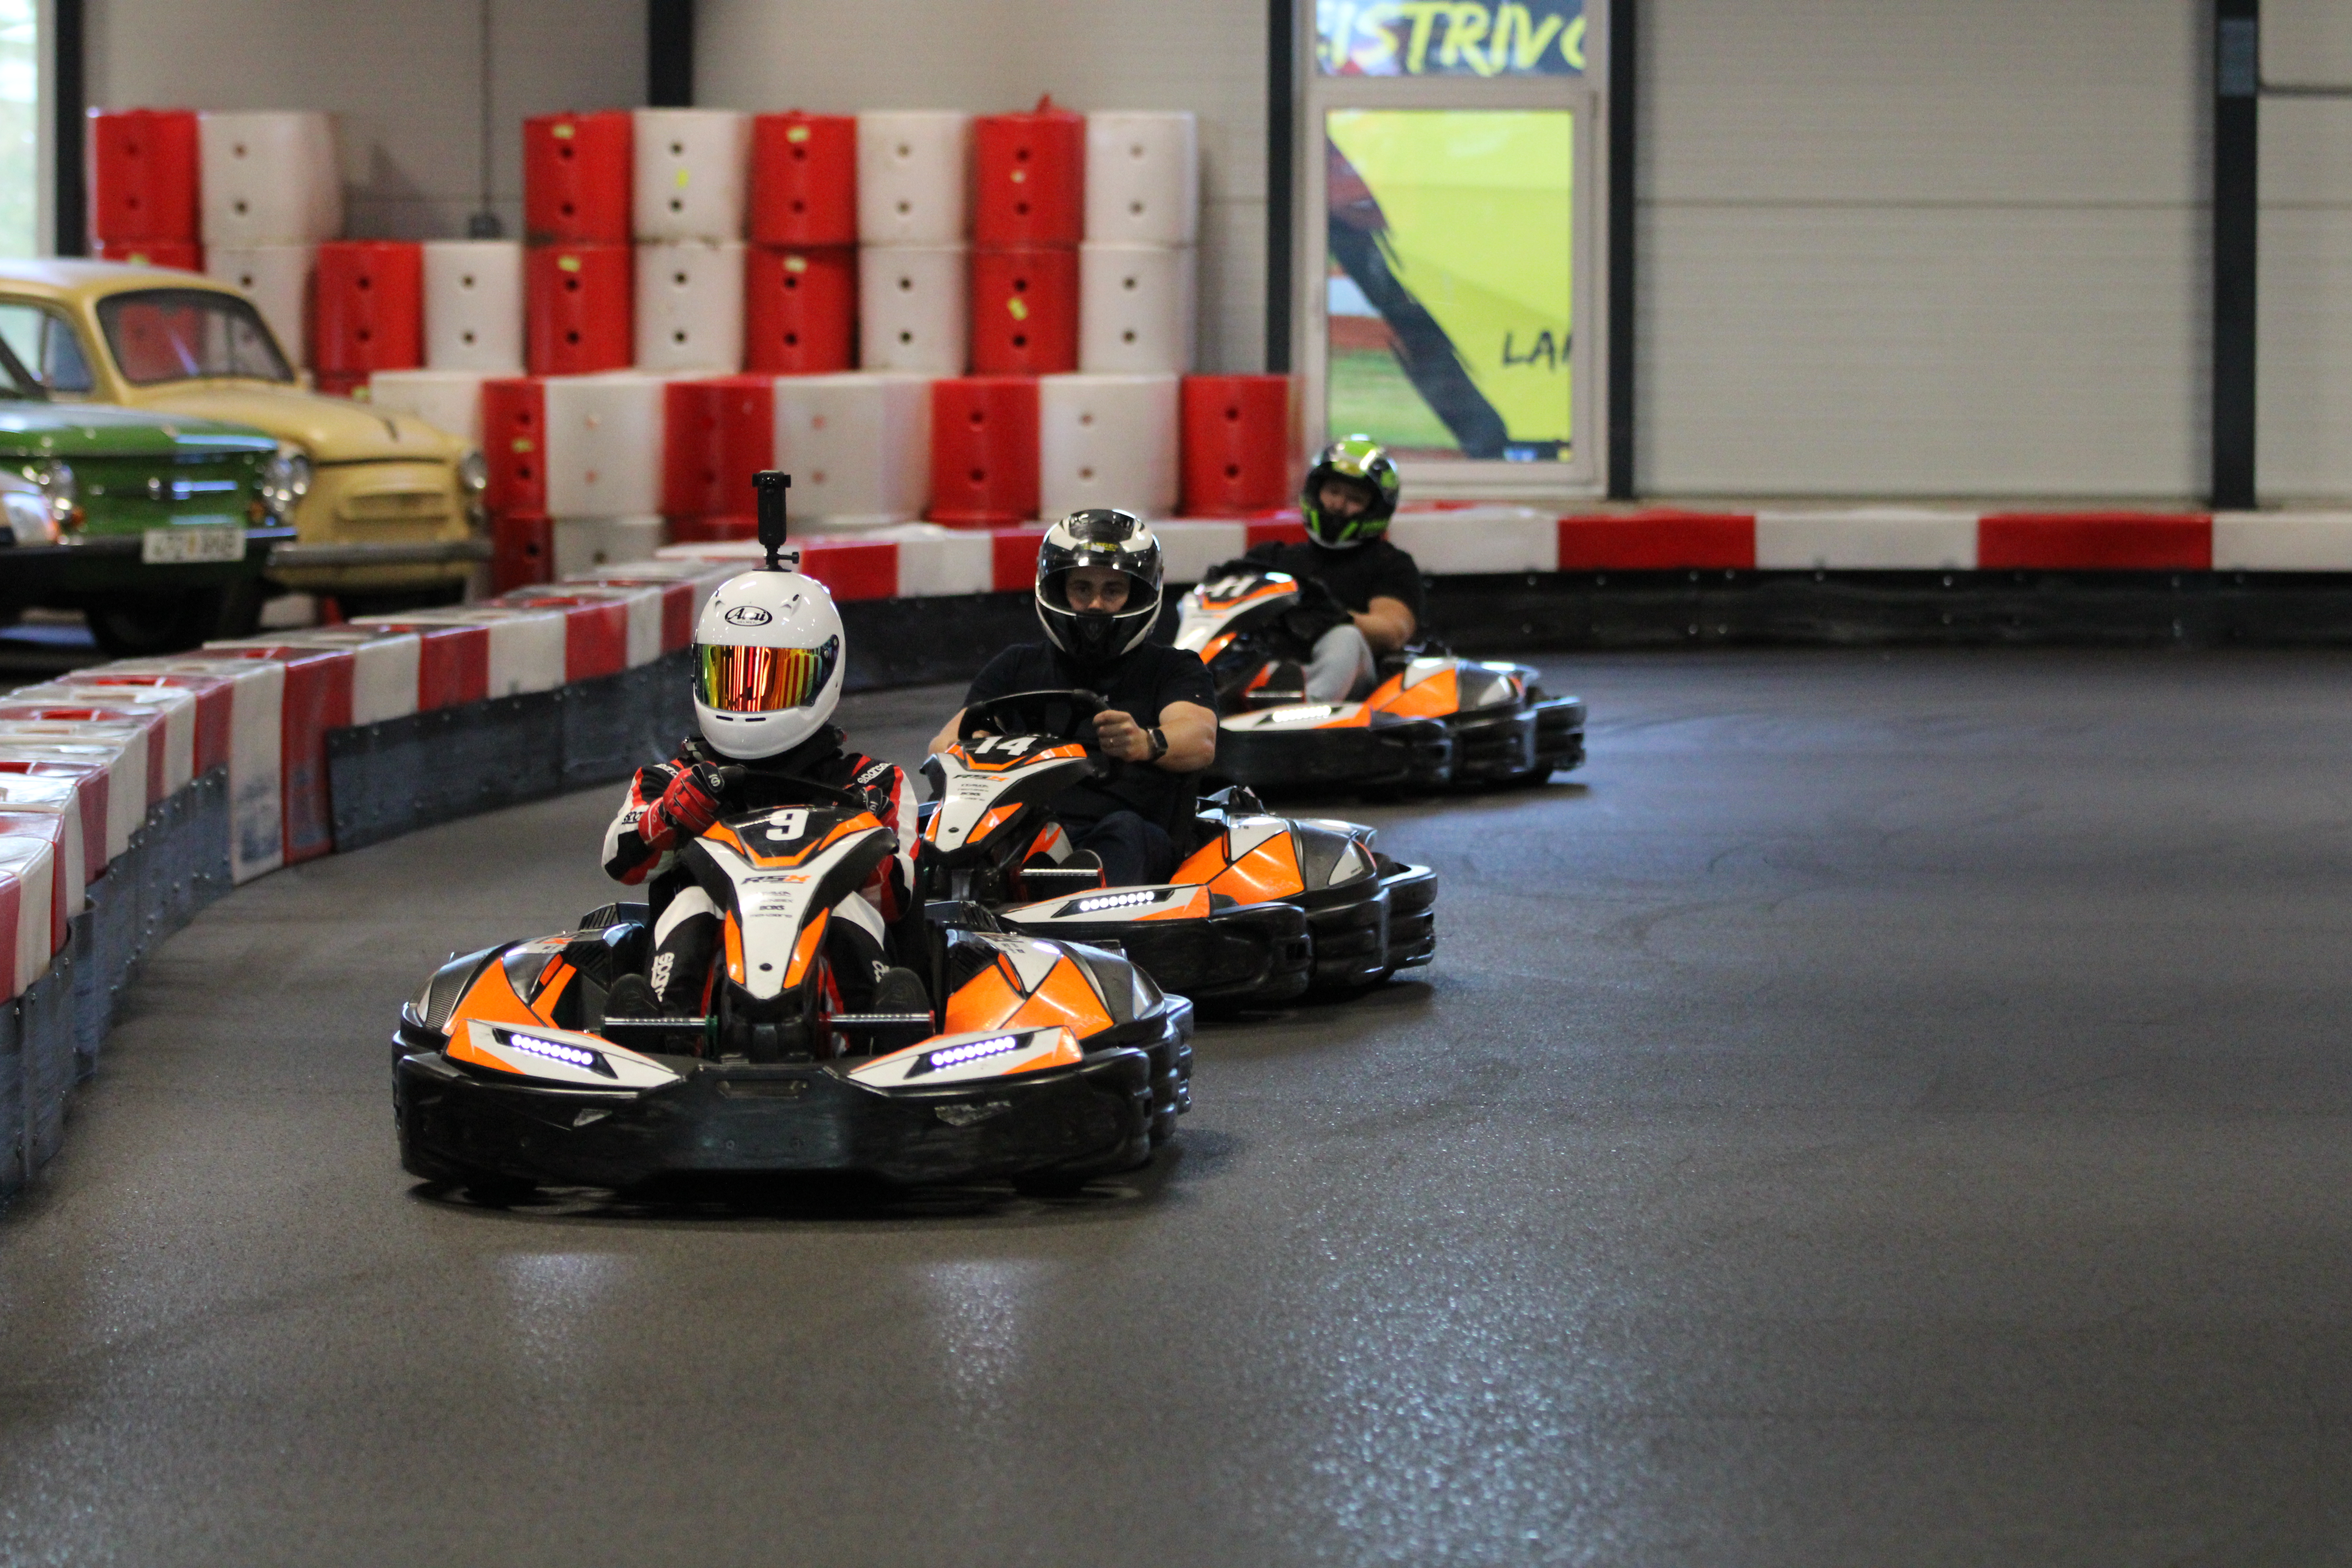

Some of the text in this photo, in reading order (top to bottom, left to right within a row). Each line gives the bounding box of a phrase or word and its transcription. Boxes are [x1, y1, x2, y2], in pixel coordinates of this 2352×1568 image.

[975, 736, 1038, 756] 14
[857, 763, 892, 784] sparco
[766, 809, 809, 840] 9
